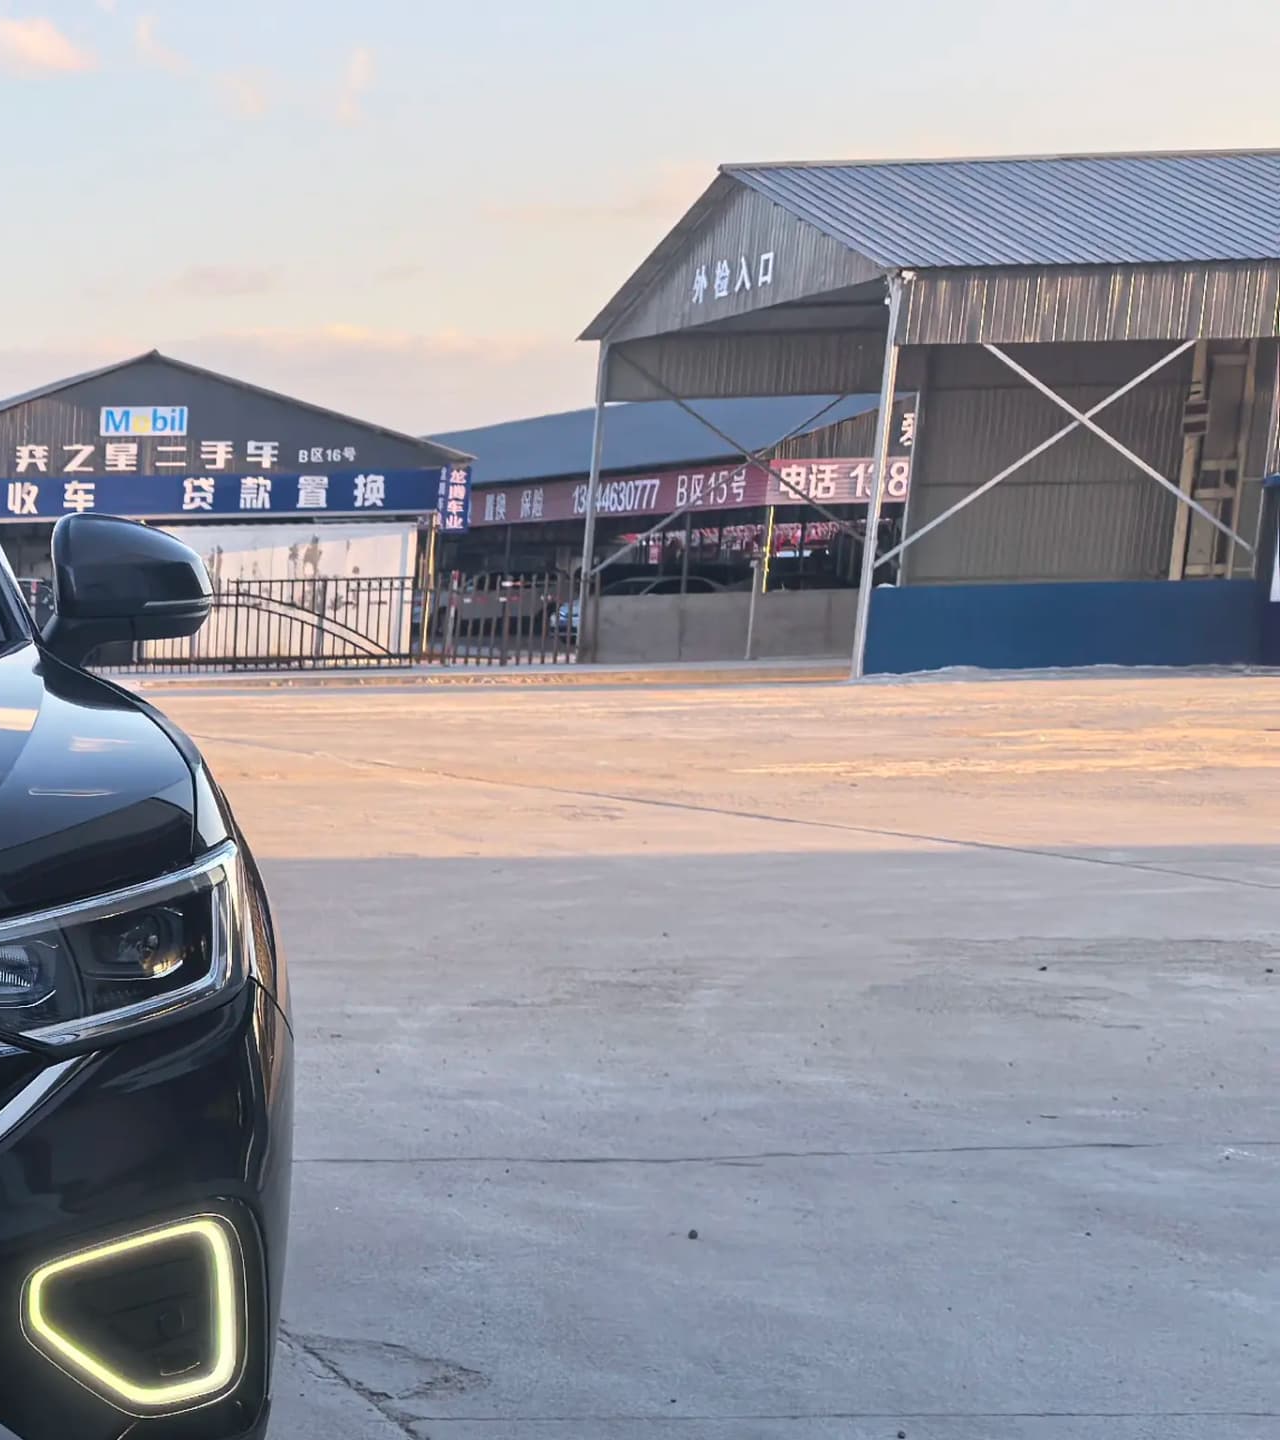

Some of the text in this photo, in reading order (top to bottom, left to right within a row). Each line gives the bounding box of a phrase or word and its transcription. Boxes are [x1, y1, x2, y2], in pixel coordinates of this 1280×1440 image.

[104, 408, 185, 433] Mobil
[298, 447, 356, 463] B区16号
[182, 474, 385, 510] 贷款置换
[779, 463, 839, 499] 电话
